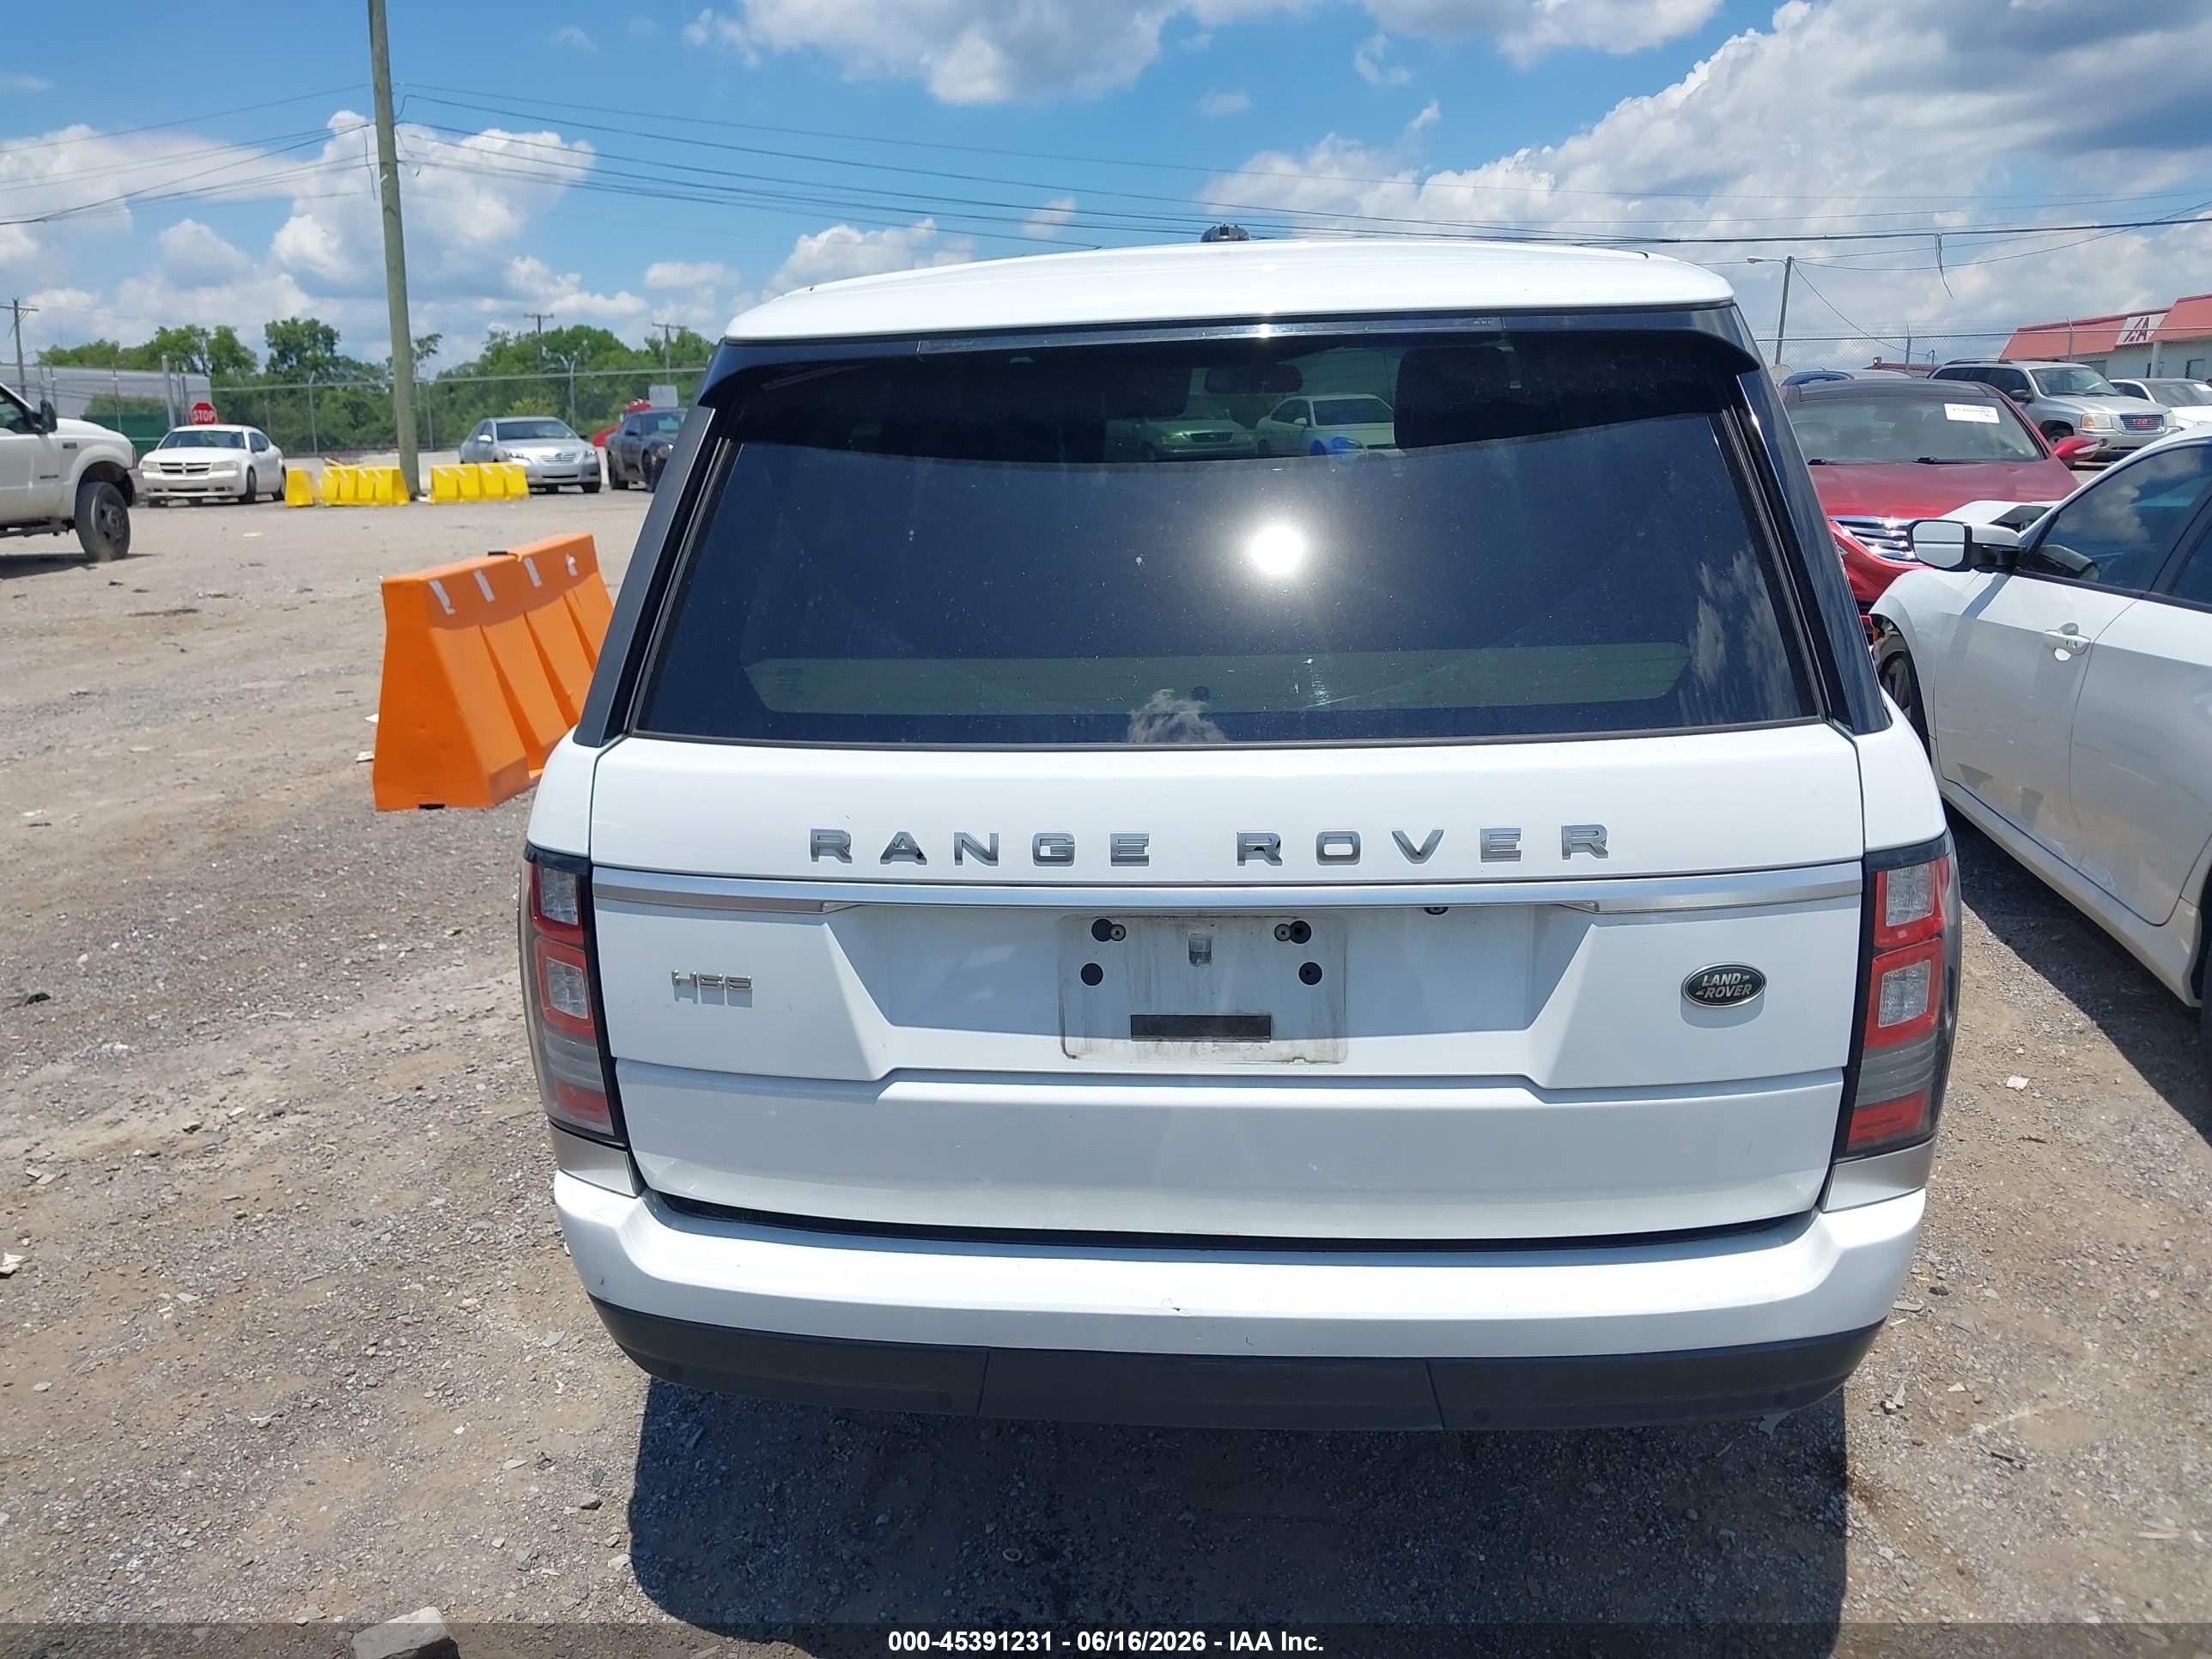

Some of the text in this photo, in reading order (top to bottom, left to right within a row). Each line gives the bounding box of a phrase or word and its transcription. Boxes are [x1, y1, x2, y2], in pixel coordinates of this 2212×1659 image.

[191, 409, 216, 422] STOP
[810, 823, 1609, 867] RANGE ROVER
[1701, 972, 1741, 988] LAND
[1703, 983, 1753, 999] ROVER
